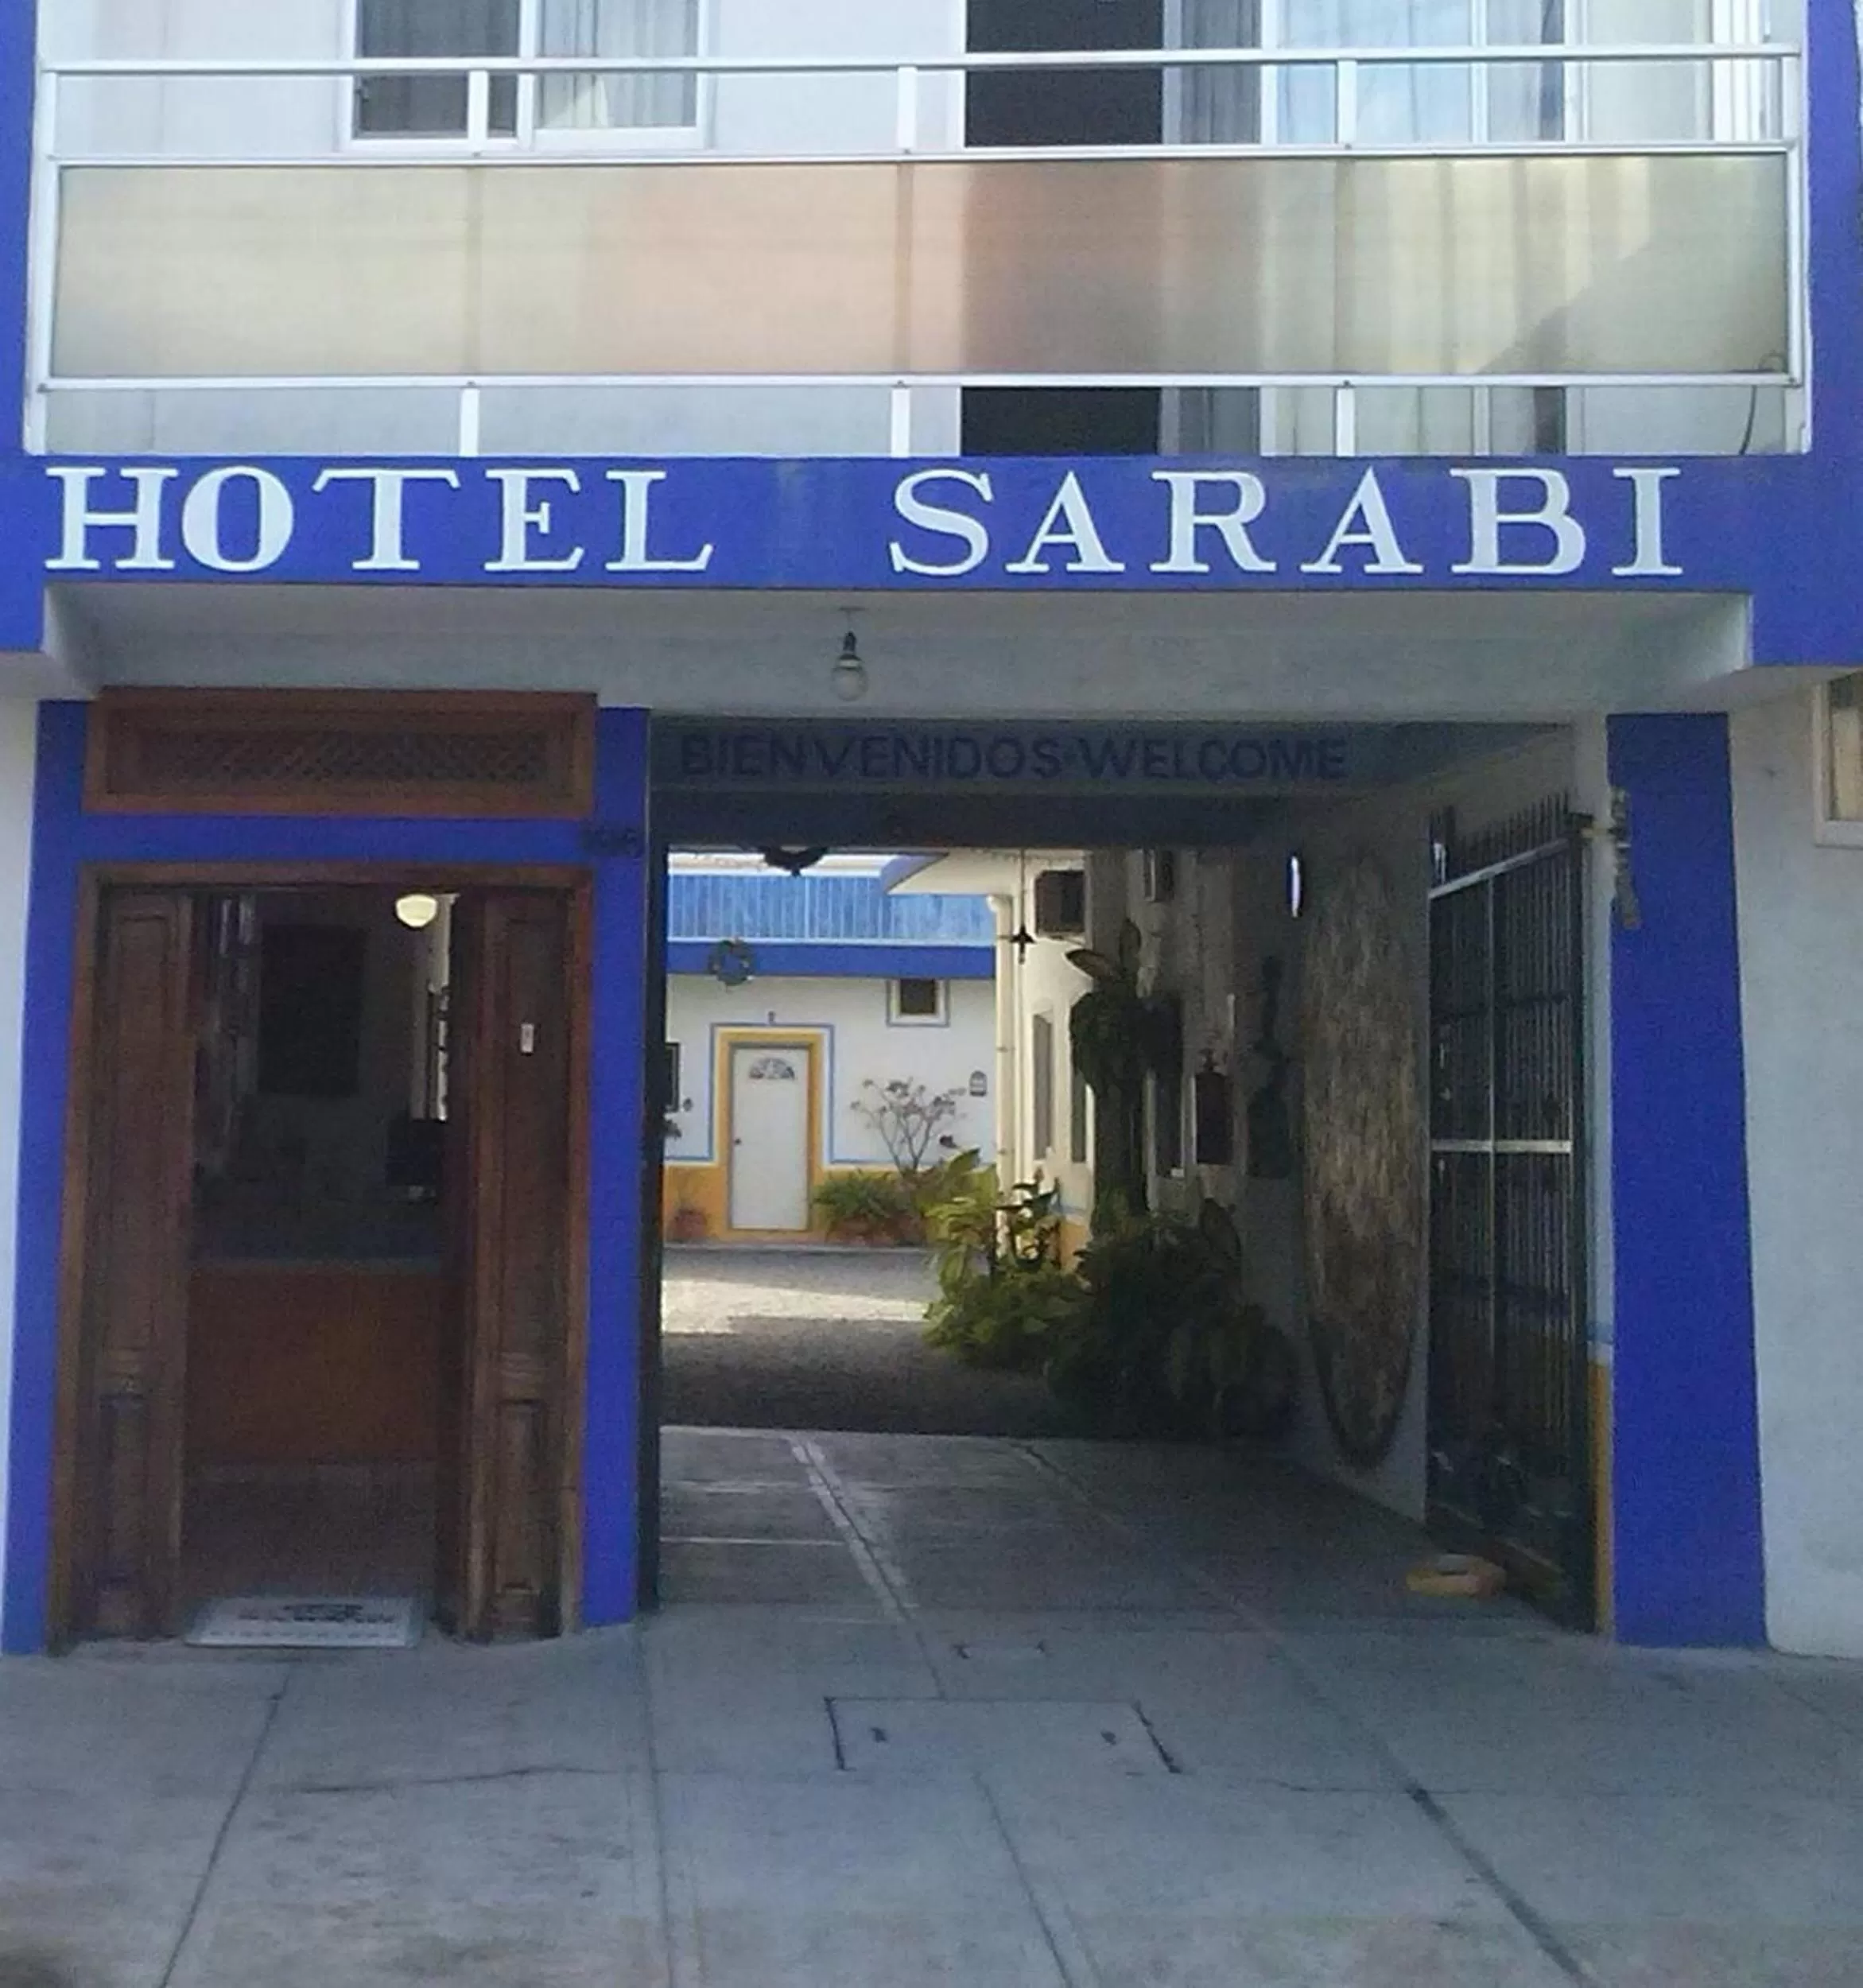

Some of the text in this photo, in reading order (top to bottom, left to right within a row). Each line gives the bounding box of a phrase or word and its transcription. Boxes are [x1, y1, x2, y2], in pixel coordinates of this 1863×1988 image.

[45, 466, 1684, 576] HOTEL SARABI
[681, 734, 1349, 780] BIENVENIDOS WELCOME
